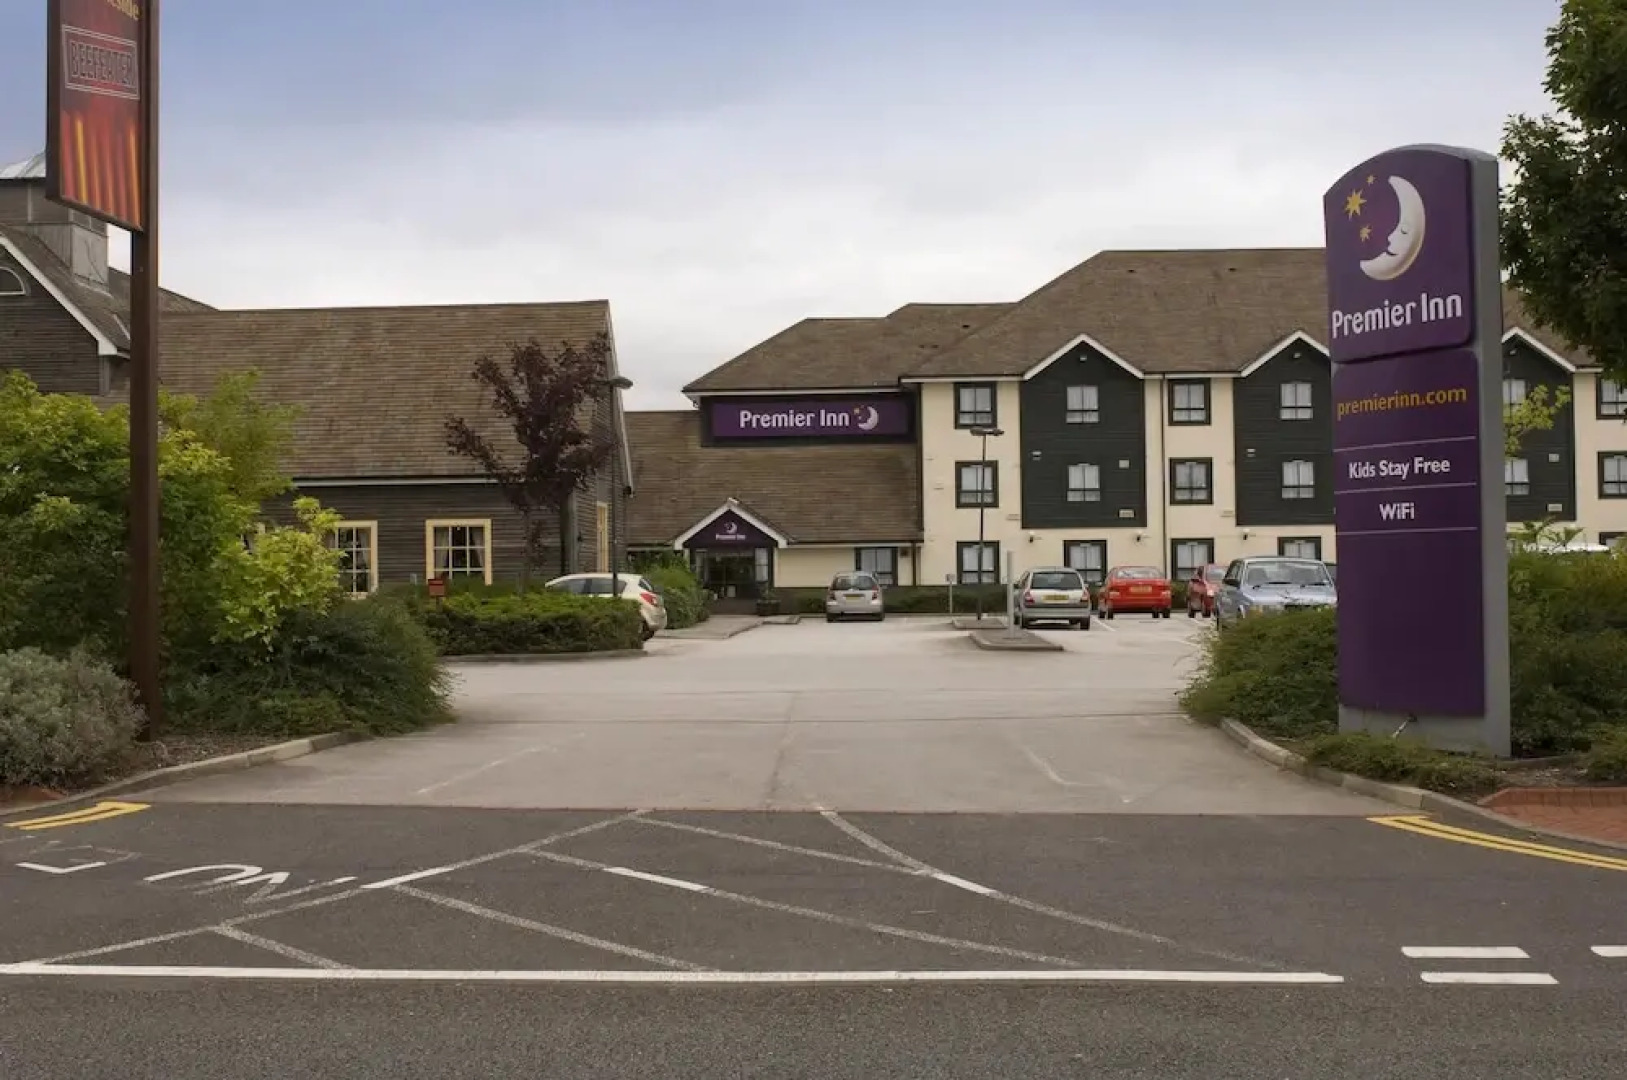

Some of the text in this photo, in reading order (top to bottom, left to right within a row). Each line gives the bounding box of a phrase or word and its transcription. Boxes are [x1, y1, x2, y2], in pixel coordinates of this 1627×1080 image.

[1332, 292, 1462, 339] Premier Inn
[1336, 388, 1467, 421] premierinn.com
[739, 409, 850, 428] Premier Inn
[1349, 456, 1450, 480] Kids Stay Free
[1379, 502, 1415, 520] WiFi
